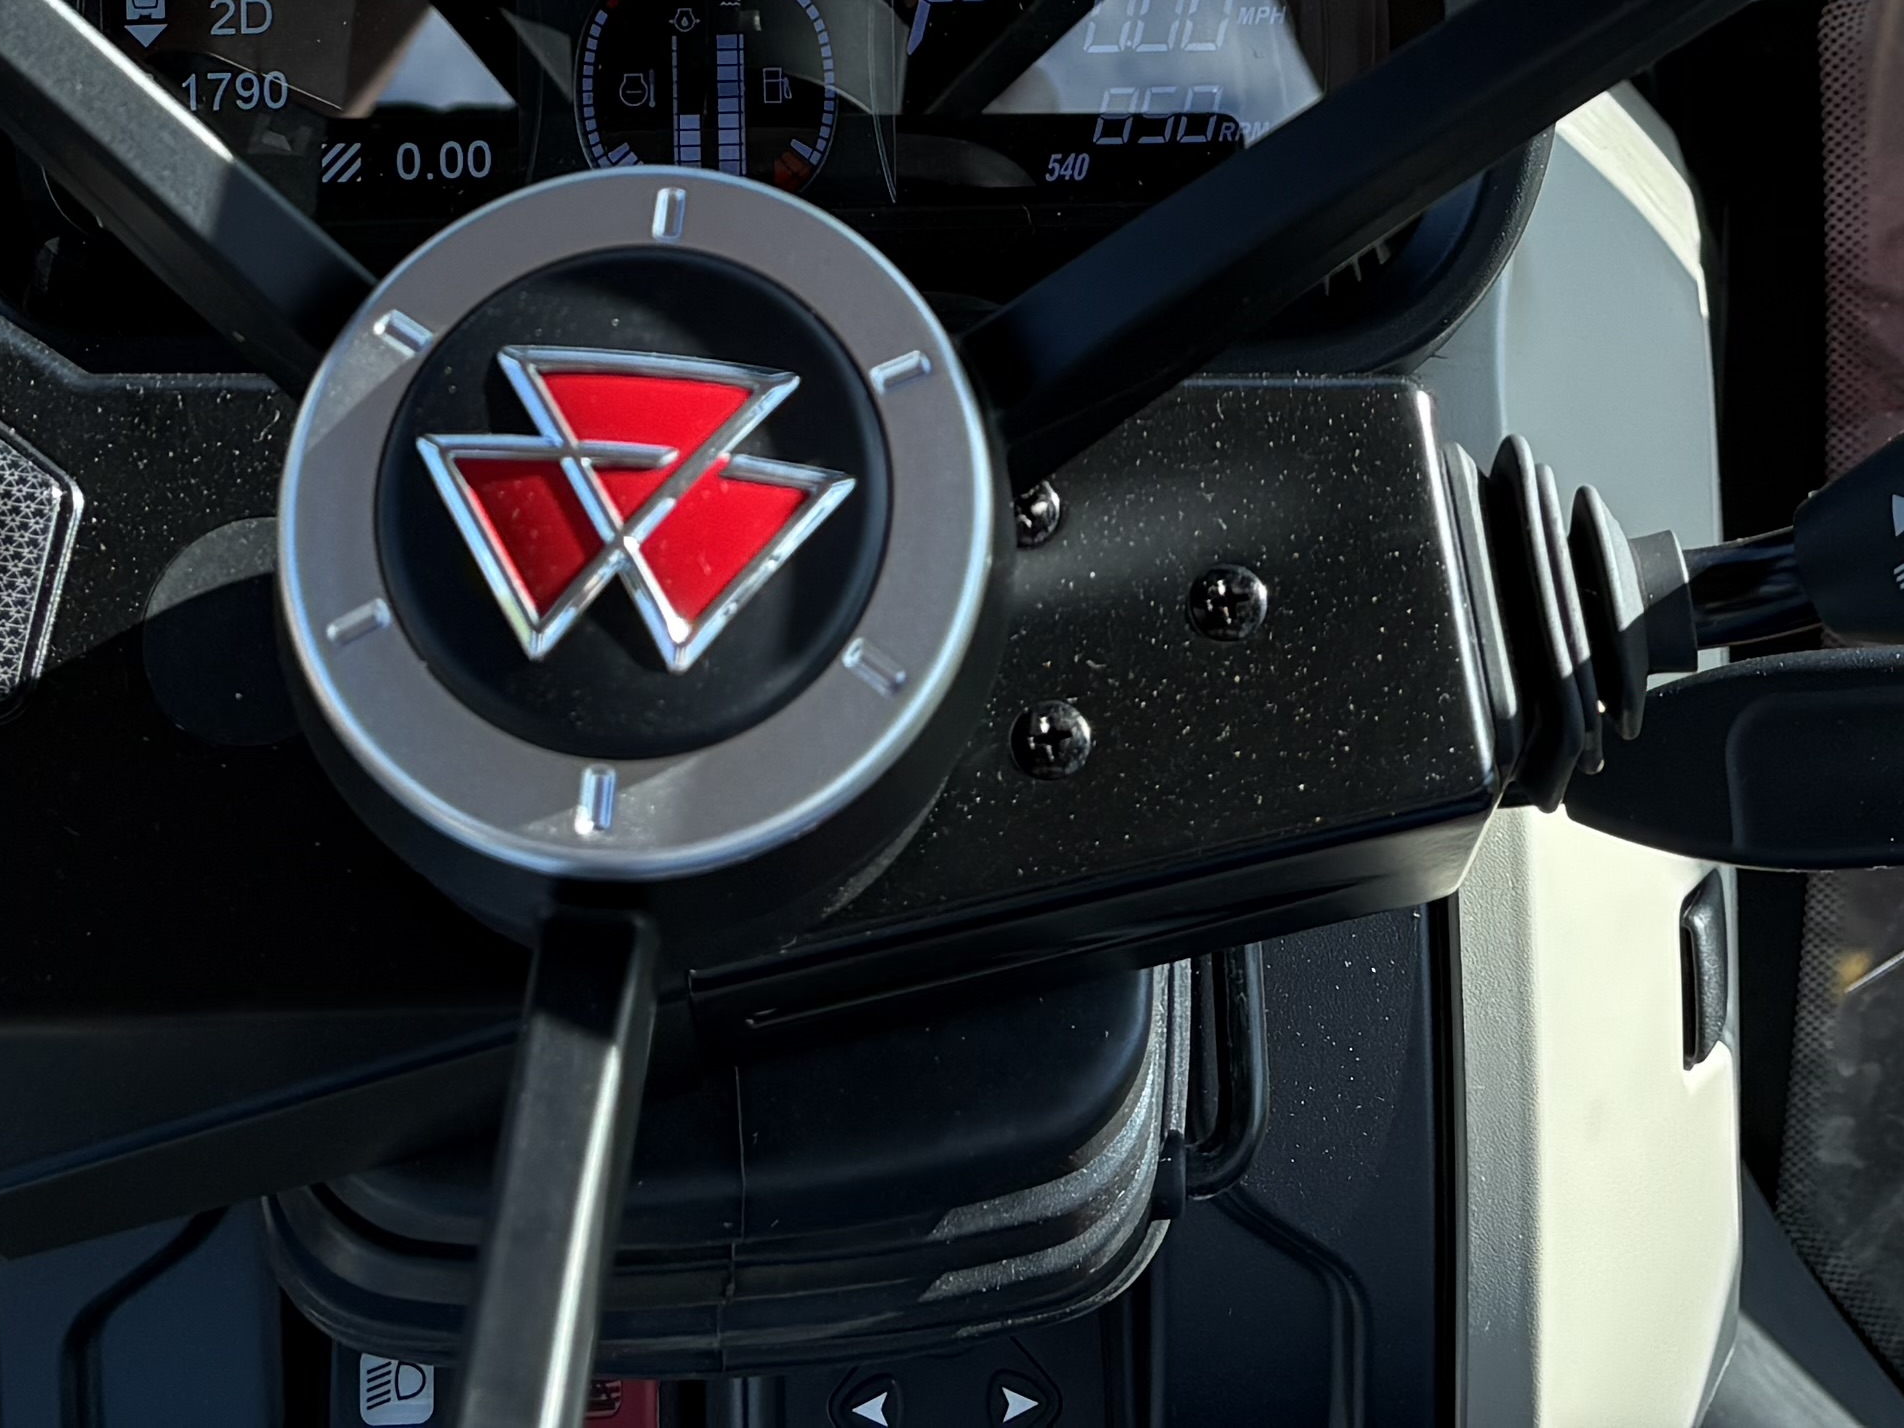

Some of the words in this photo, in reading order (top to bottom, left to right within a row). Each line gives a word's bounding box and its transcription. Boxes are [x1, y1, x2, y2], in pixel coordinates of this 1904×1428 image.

[1237, 5, 1288, 26] MPH
[181, 70, 289, 111] 1790
[1093, 84, 1224, 145] 850
[1218, 120, 1270, 142] RPM
[396, 139, 492, 181] 0.00
[1045, 152, 1091, 183] 540
